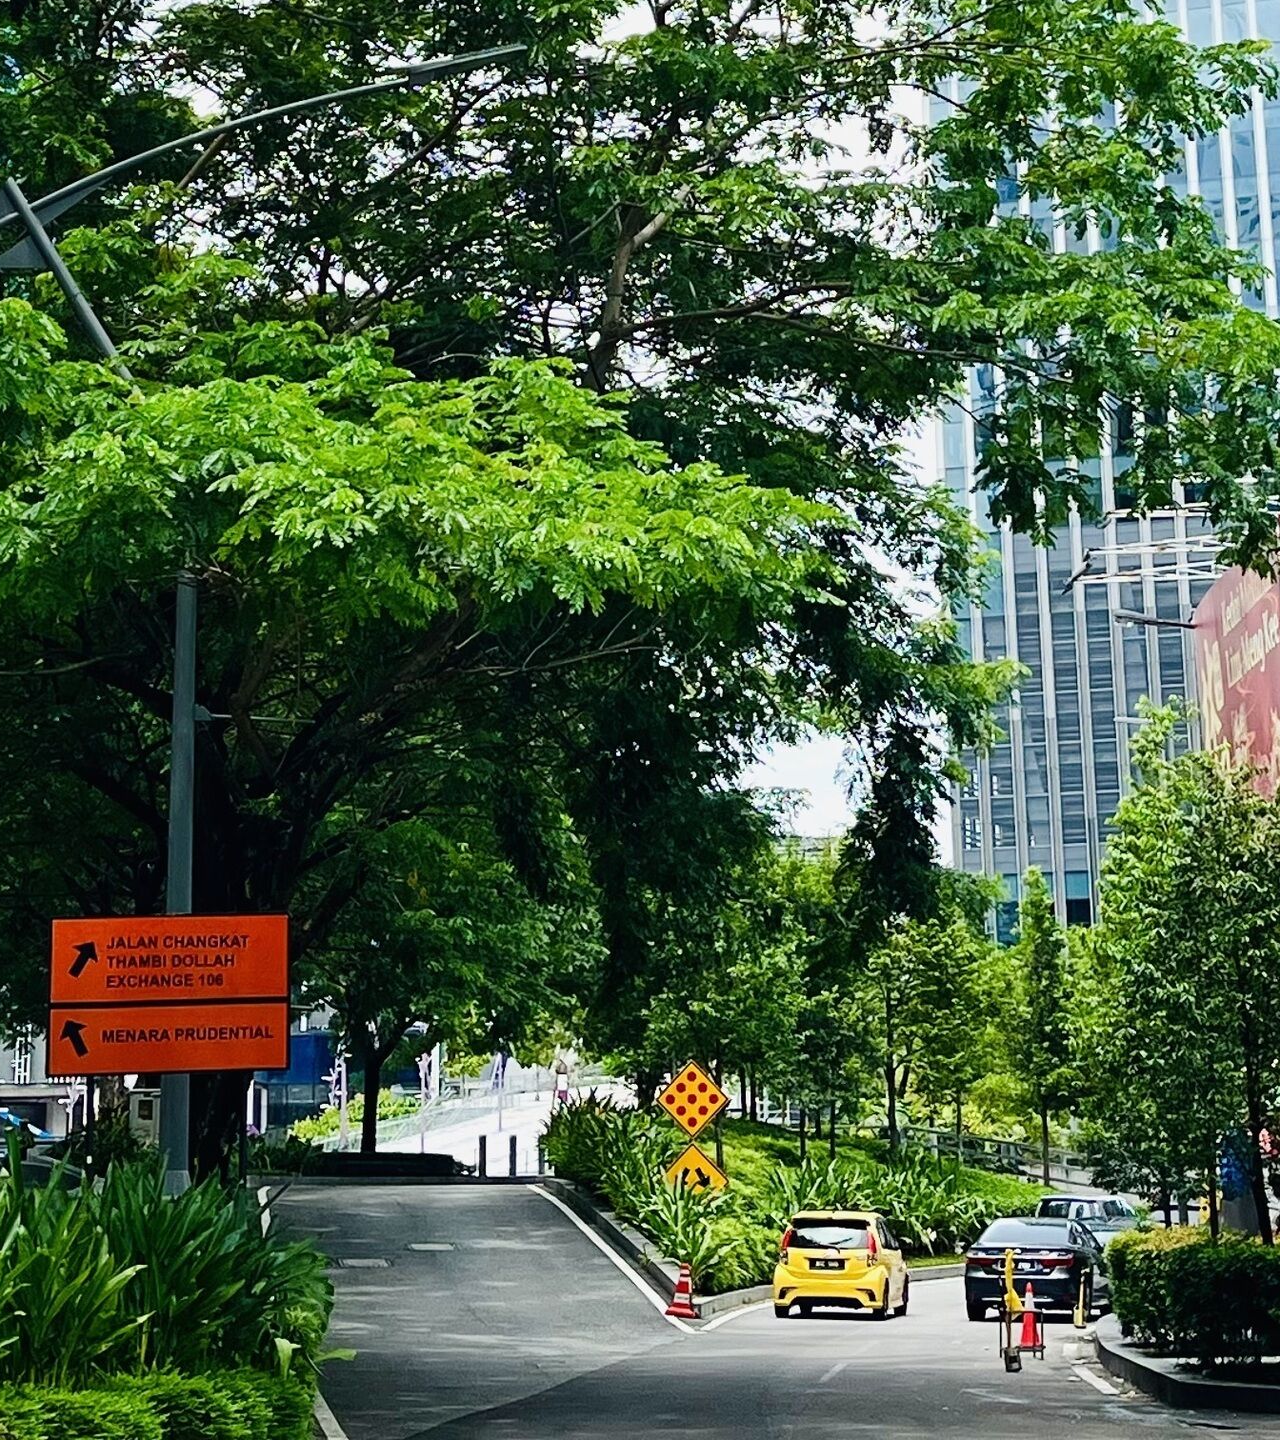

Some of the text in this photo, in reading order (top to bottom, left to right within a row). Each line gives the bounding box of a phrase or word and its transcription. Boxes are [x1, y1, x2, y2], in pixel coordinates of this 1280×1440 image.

[106, 934, 249, 950] JALAN CHANGKAT
[106, 953, 235, 969] THAMBI DOLLAH
[106, 973, 223, 988] EXCHANGE 106
[102, 1025, 274, 1043] MENARA PRUDENTIAL
